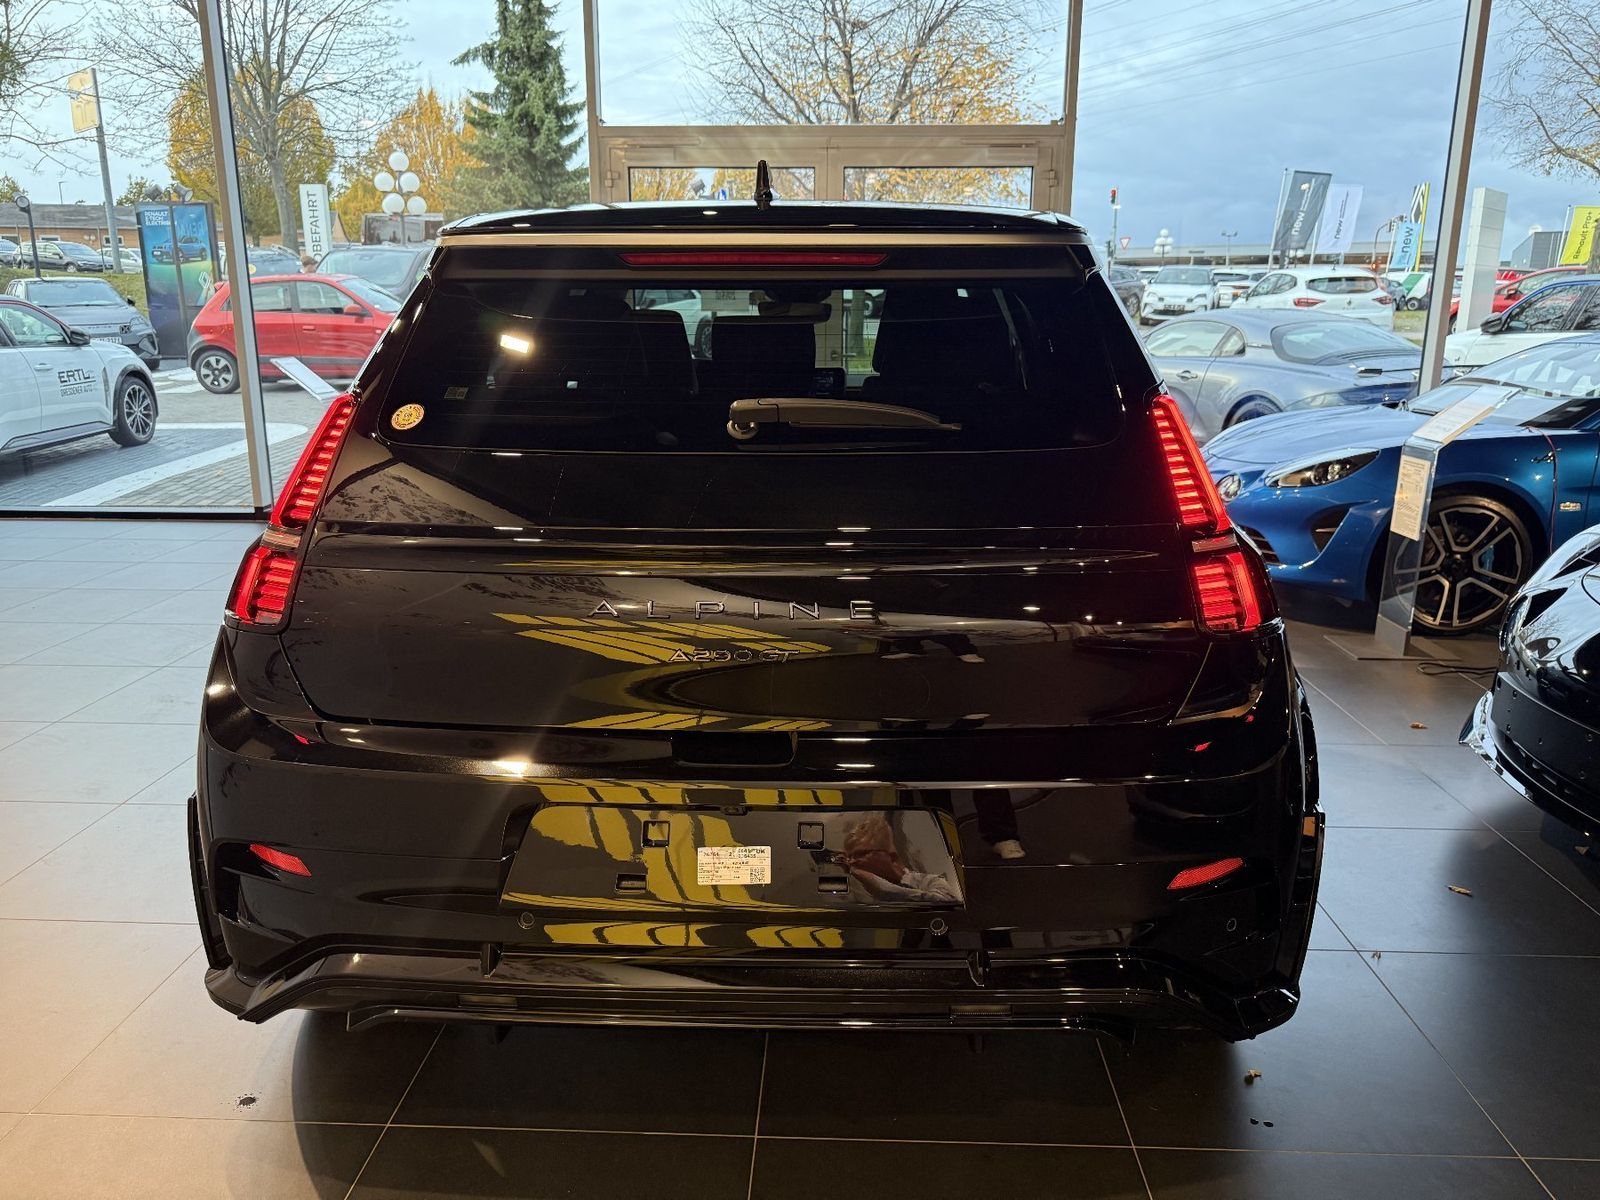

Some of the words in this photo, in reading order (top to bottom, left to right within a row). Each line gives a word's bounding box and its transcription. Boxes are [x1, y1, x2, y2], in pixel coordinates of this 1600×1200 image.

[1292, 212, 1304, 235] new
[1402, 226, 1413, 253] new
[1573, 230, 1588, 259] Renault
[58, 369, 90, 383] ERTL
[587, 599, 876, 620] ALPINE
[668, 649, 752, 662] A290
[758, 649, 799, 663] GT
